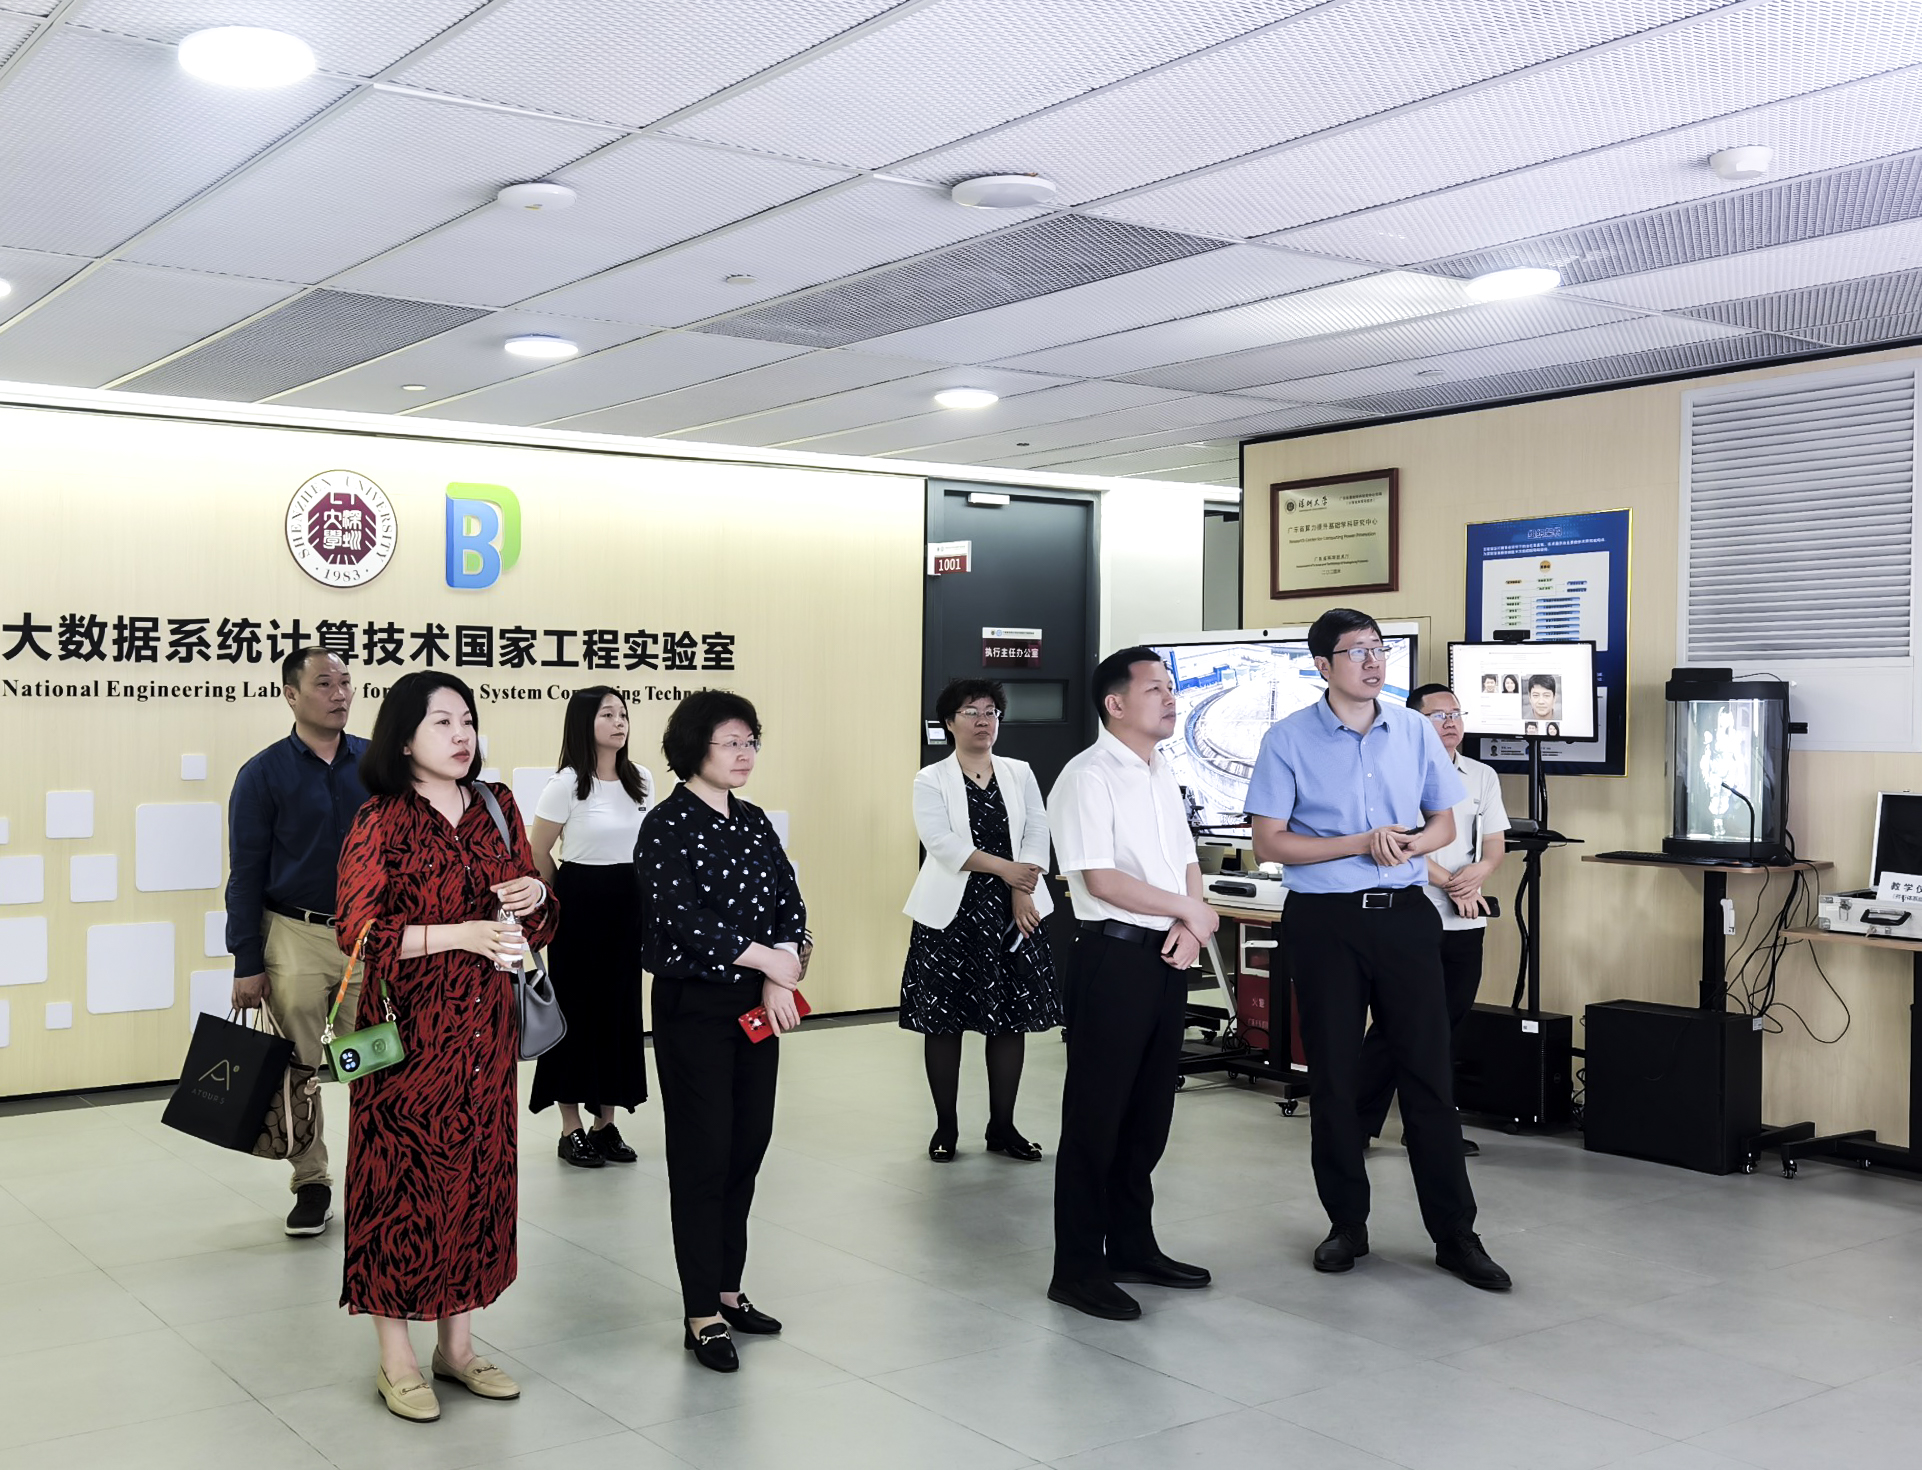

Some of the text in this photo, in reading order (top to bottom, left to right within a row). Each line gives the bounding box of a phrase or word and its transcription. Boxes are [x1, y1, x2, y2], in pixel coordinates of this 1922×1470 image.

[291, 476, 393, 562] SHENZHEN UNIVERSITY
[938, 558, 961, 571] 1001
[324, 568, 360, 582] 1983
[2, 612, 736, 671] 大数据系统计算技术国家工程实验室
[985, 647, 1039, 658] 执行主任办公室
[2, 679, 99, 698] National
[107, 680, 237, 702] Engineering
[480, 684, 542, 703] System
